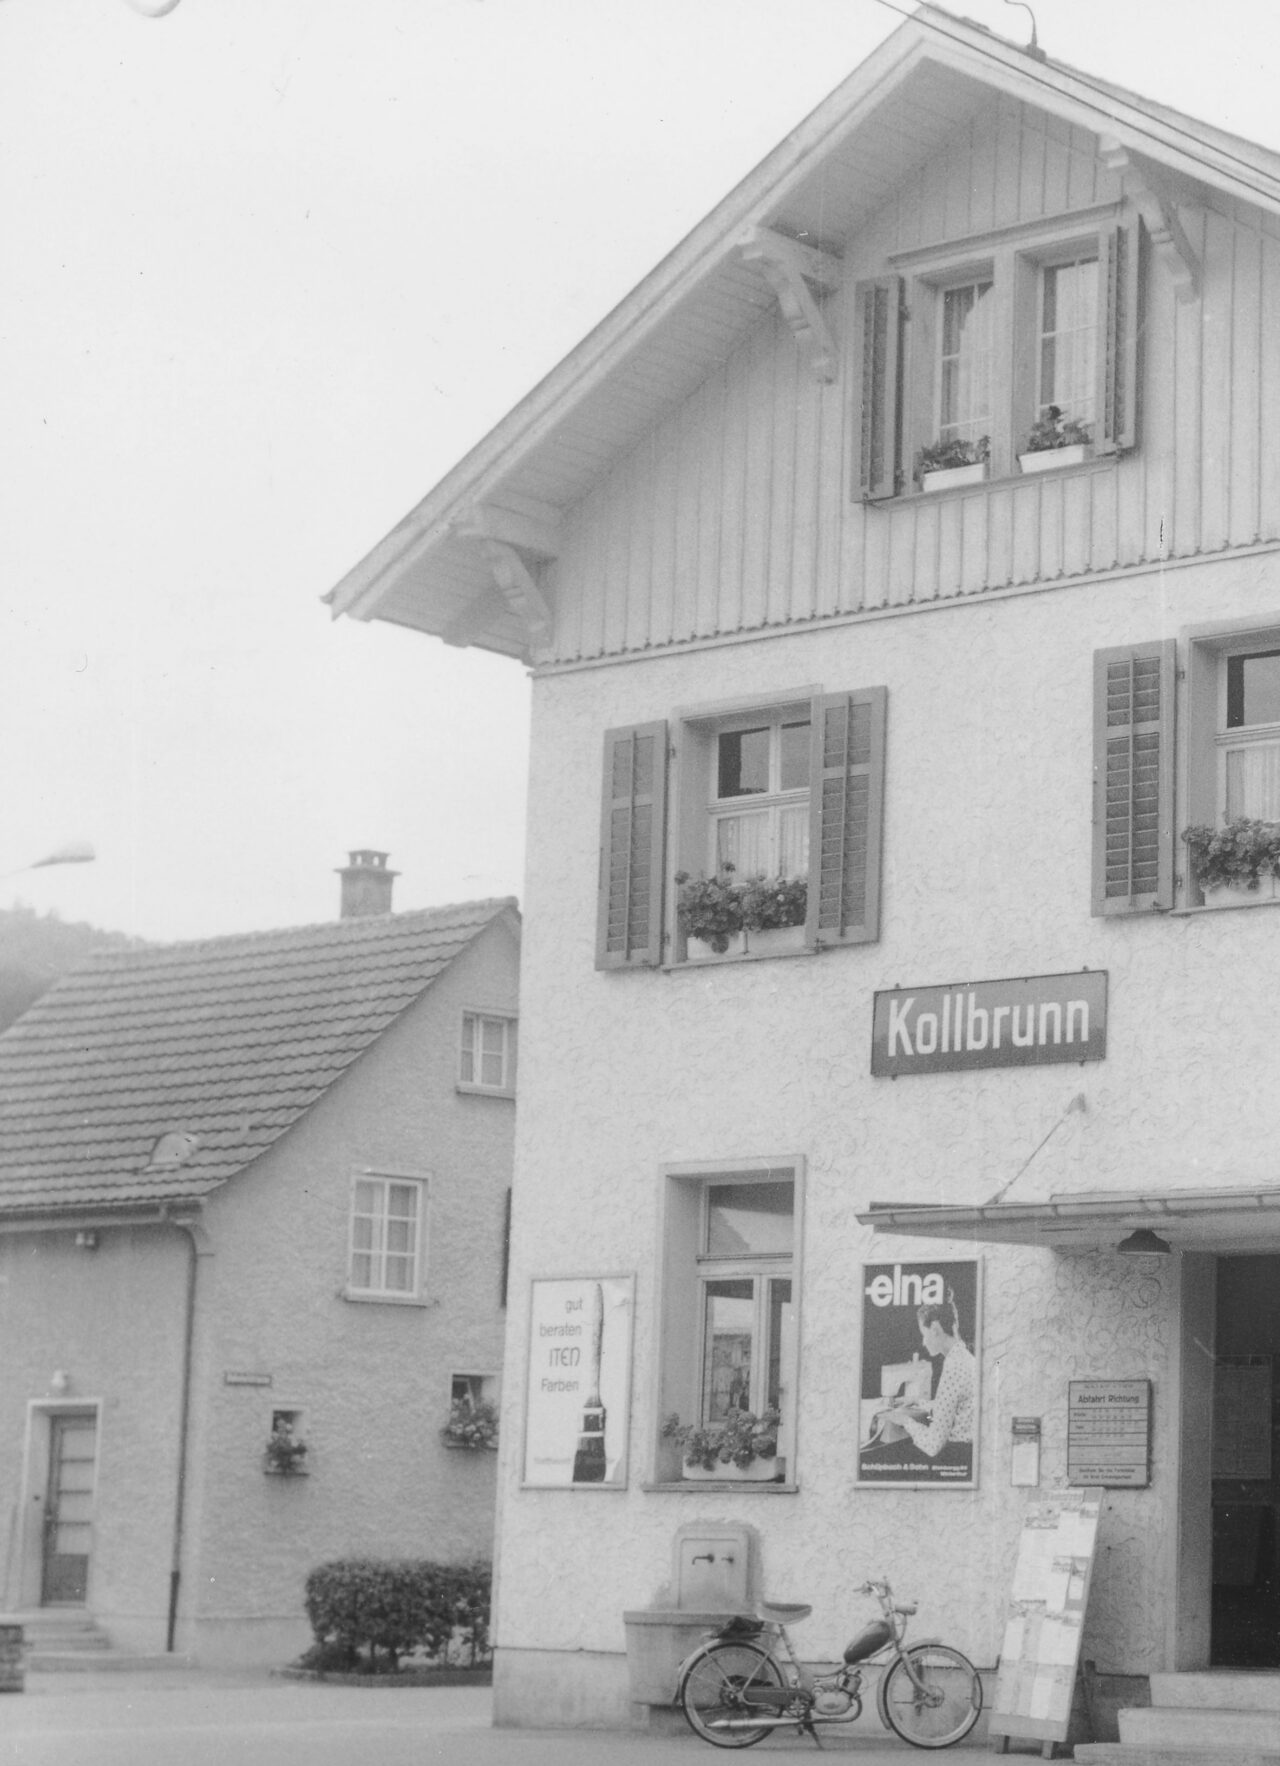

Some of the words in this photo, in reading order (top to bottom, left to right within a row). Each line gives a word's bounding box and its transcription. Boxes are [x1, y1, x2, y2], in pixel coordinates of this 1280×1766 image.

[887, 992, 1090, 1057] Kollbrunn
[865, 1264, 944, 1307] elna
[565, 1298, 583, 1314] gut
[539, 1323, 582, 1338] beraten
[541, 1378, 580, 1393] Farben
[1078, 1394, 1106, 1404] Abfahrt
[1108, 1394, 1140, 1404] Richtung
